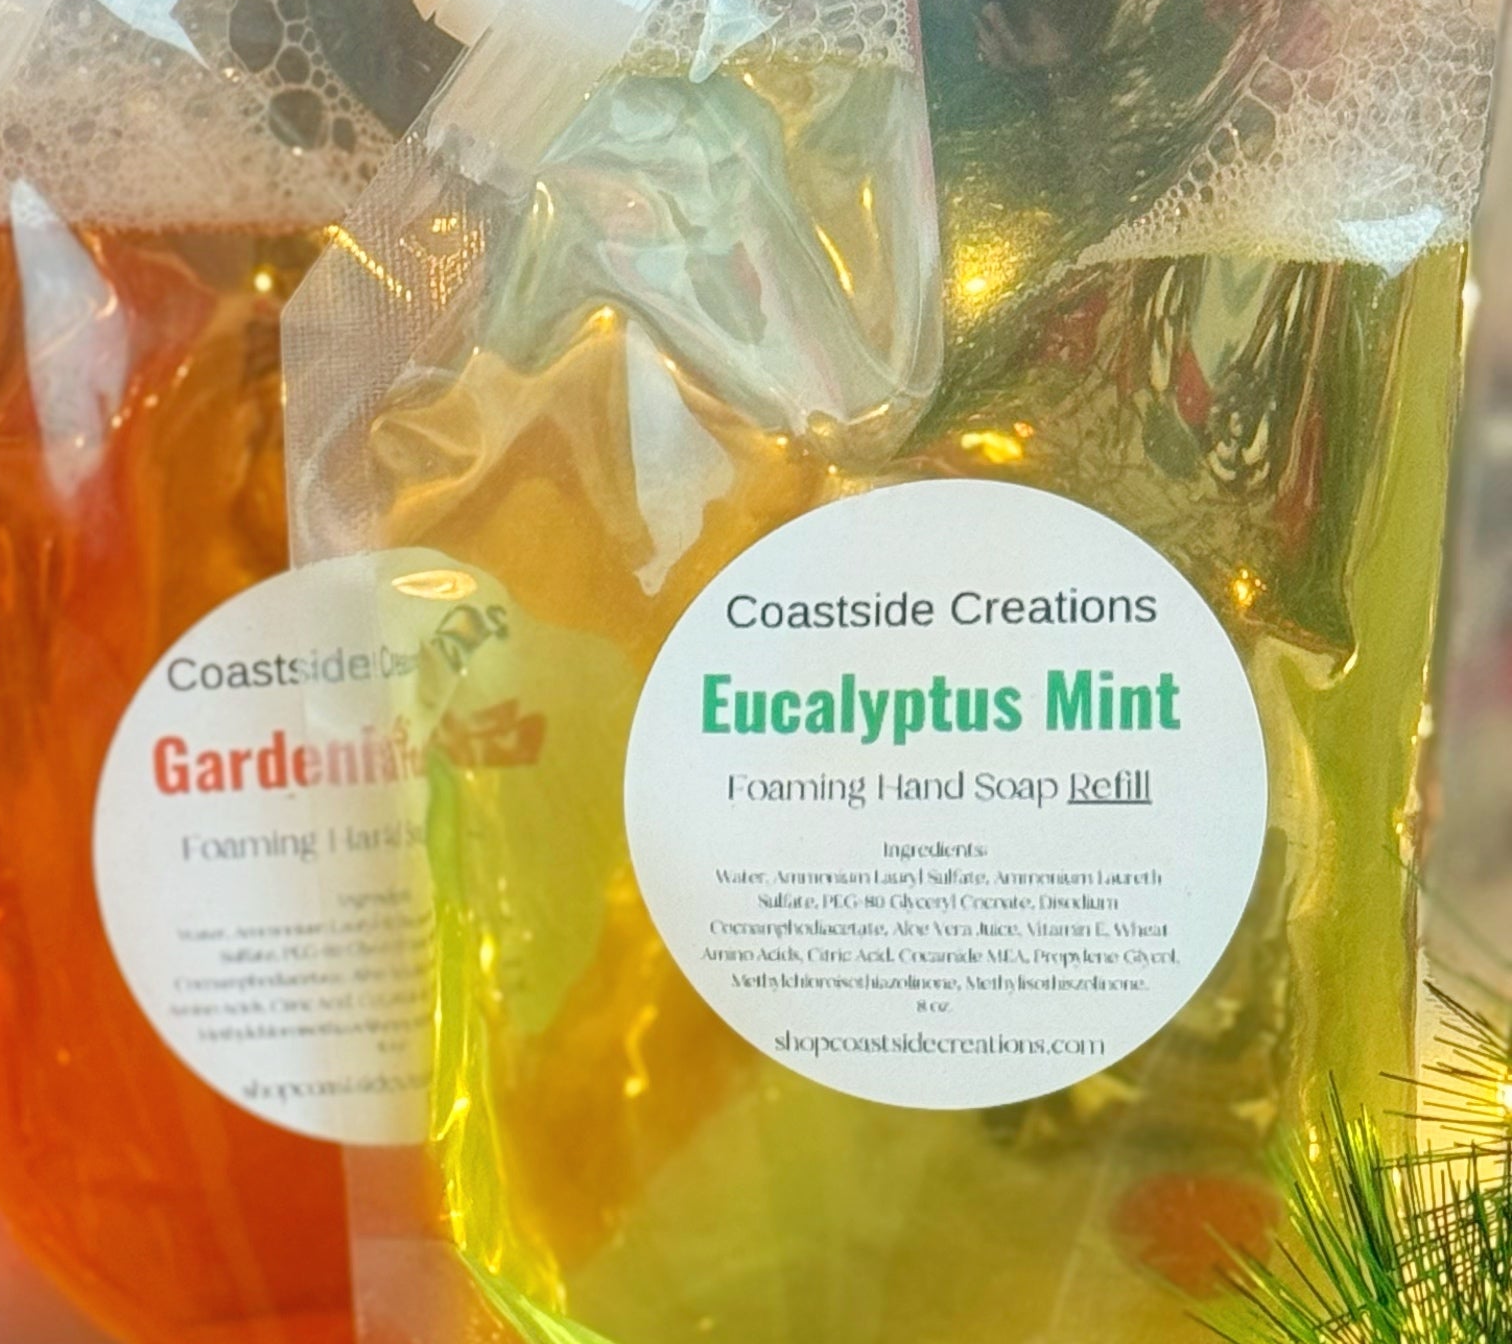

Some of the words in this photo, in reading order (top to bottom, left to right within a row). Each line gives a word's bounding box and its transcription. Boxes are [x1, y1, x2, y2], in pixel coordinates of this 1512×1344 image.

[725, 591, 935, 630] Coastside
[949, 587, 1158, 626] Creations
[166, 645, 372, 693] Coastside
[701, 673, 1024, 746] Eucalyptus
[1045, 669, 1182, 733] Mint
[726, 771, 866, 809] Foaming
[877, 771, 965, 801] Hand
[974, 771, 1059, 808] Soap
[1067, 768, 1153, 806] Refill
[180, 828, 318, 864] Foaming
[773, 1029, 1105, 1059] shopcoastsidecreations.com
